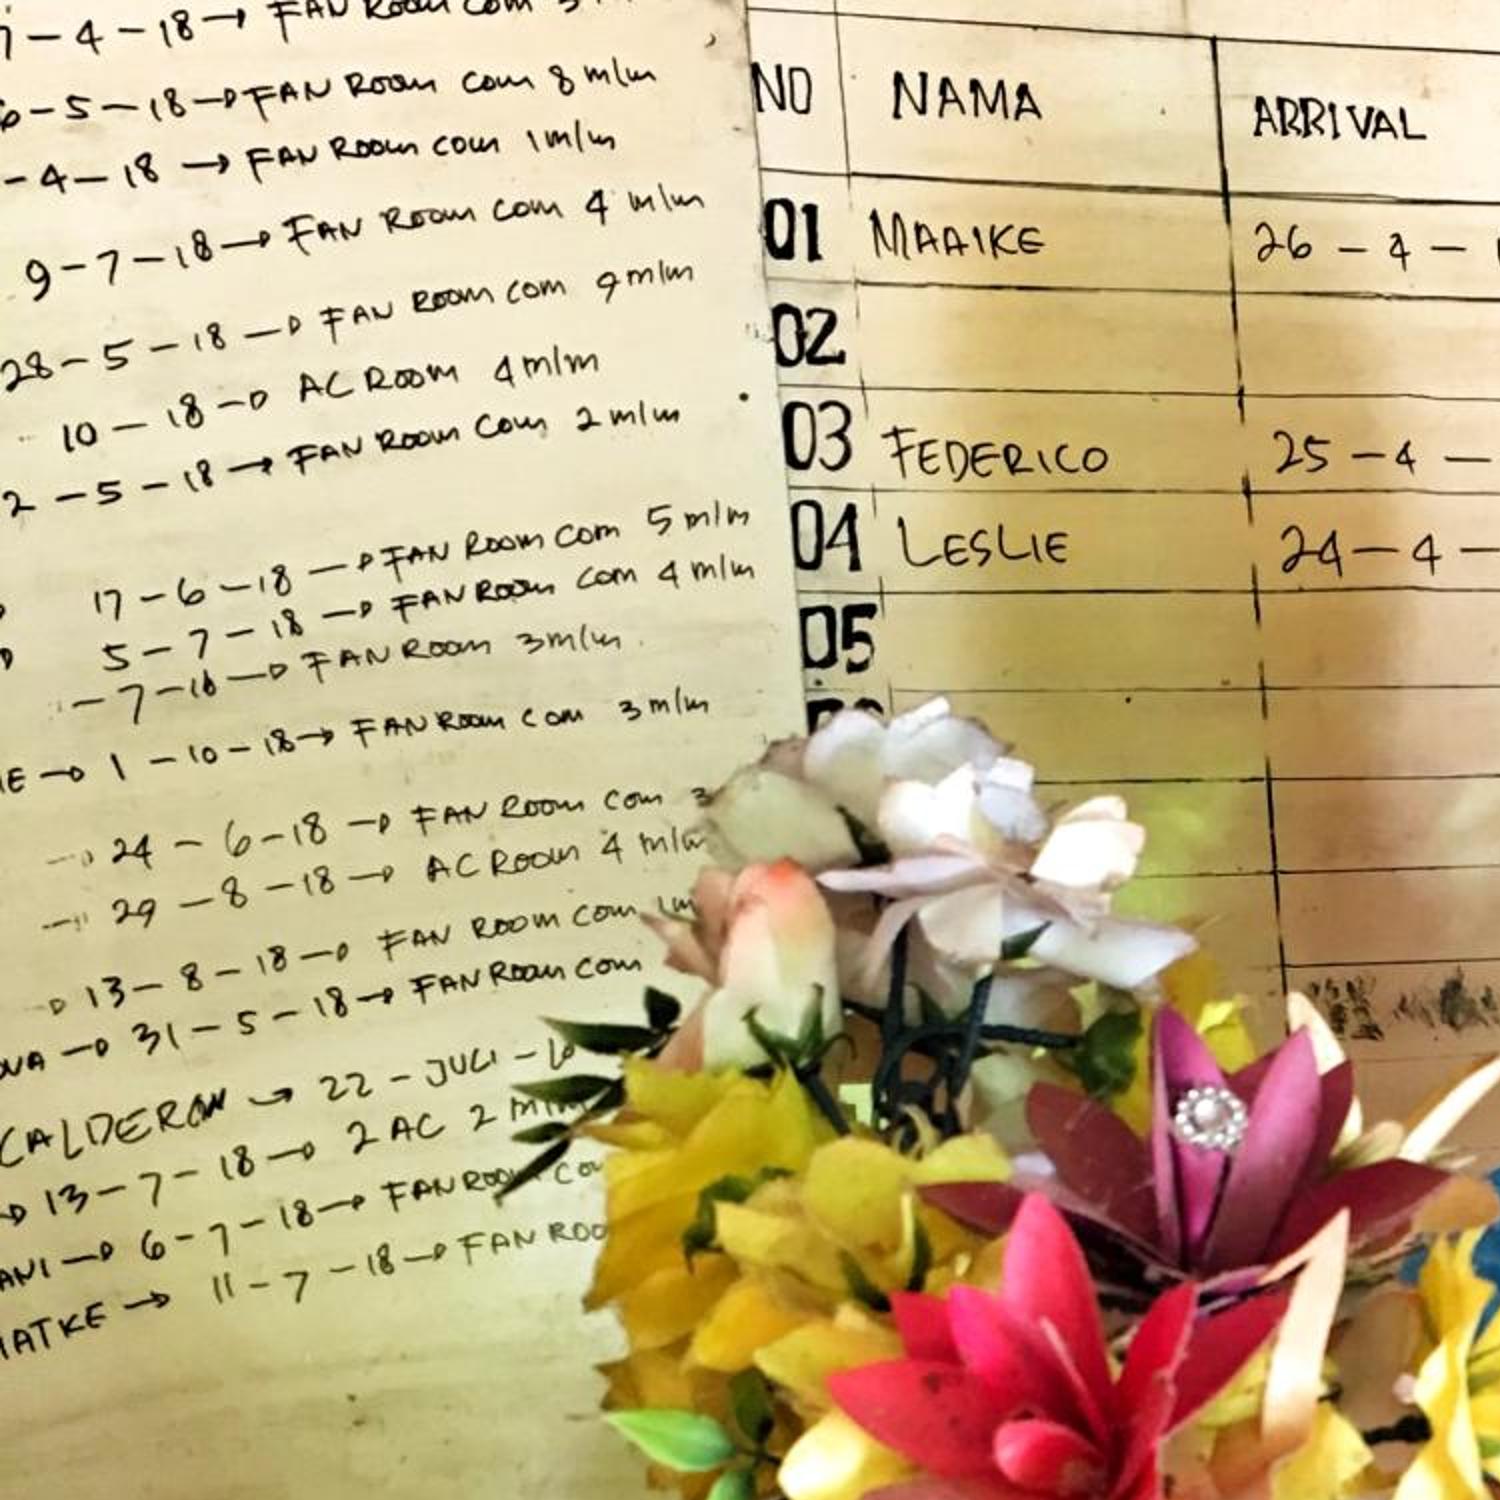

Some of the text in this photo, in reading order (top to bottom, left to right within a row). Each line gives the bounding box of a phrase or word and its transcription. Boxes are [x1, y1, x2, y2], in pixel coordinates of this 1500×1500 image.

[240, 77, 332, 123] FAN
[547, 63, 576, 97] 8
[751, 62, 814, 115] NO
[891, 69, 1043, 122] NAMA
[1252, 95, 1428, 141] ARRIVAL
[244, 144, 319, 185] FAN
[281, 213, 363, 257] FAN
[584, 188, 609, 227] 4
[761, 202, 824, 263] 01
[868, 207, 1046, 261] MAAIKE
[318, 301, 394, 346] FAN
[595, 270, 622, 305] 9
[769, 302, 847, 369] 02
[298, 370, 355, 404] AC
[493, 354, 516, 389] 4
[285, 435, 363, 476] FAN
[575, 405, 603, 433] 2
[780, 399, 853, 473] 03
[880, 425, 1109, 483] FEDERICO
[379, 541, 450, 583] FAN
[646, 503, 673, 537] 5
[789, 498, 863, 573] 04
[896, 515, 1069, 568] LESLIE
[389, 584, 466, 625] FAN
[657, 559, 680, 590] 4
[300, 645, 391, 685] FAN
[797, 602, 878, 675] 05
[349, 715, 429, 749] FAN
[618, 699, 643, 722] 3
[410, 801, 489, 837] FAN
[426, 852, 481, 884] AC
[600, 829, 623, 865] 4
[376, 924, 451, 962] FAN
[408, 968, 481, 1005] FAN
[346, 1120, 380, 1156] 2
[390, 1112, 447, 1142] AC
[468, 1103, 498, 1133] 2
[379, 1176, 456, 1213] FAN
[456, 1229, 537, 1266] FAN
